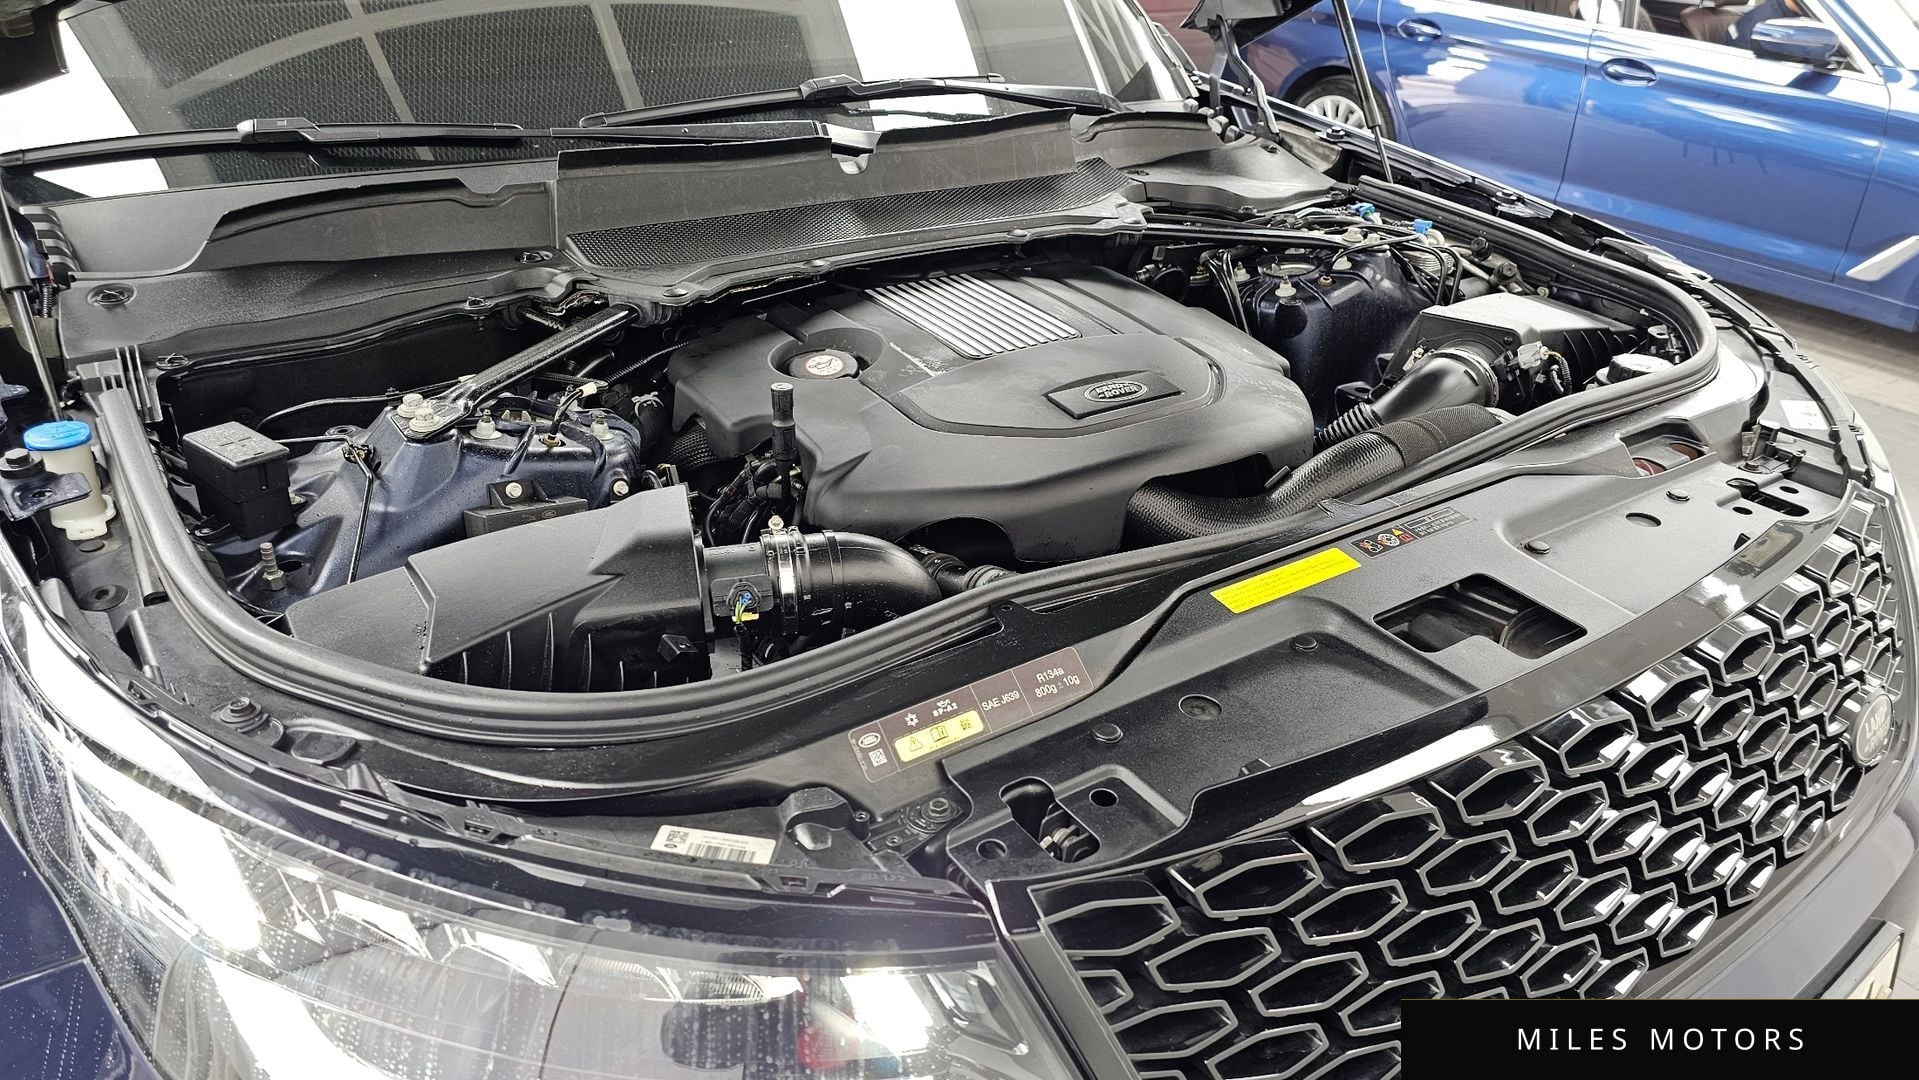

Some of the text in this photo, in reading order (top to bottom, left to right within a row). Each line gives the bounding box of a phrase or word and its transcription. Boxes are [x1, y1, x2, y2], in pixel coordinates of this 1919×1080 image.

[1095, 381, 1127, 394] LAND
[1103, 385, 1139, 398] ROVER
[1036, 667, 1064, 683] R134a
[1035, 684, 1058, 698] 800g
[1063, 675, 1080, 687] 10g
[981, 690, 1020, 711] SAE J639
[1864, 706, 1887, 740] LAND
